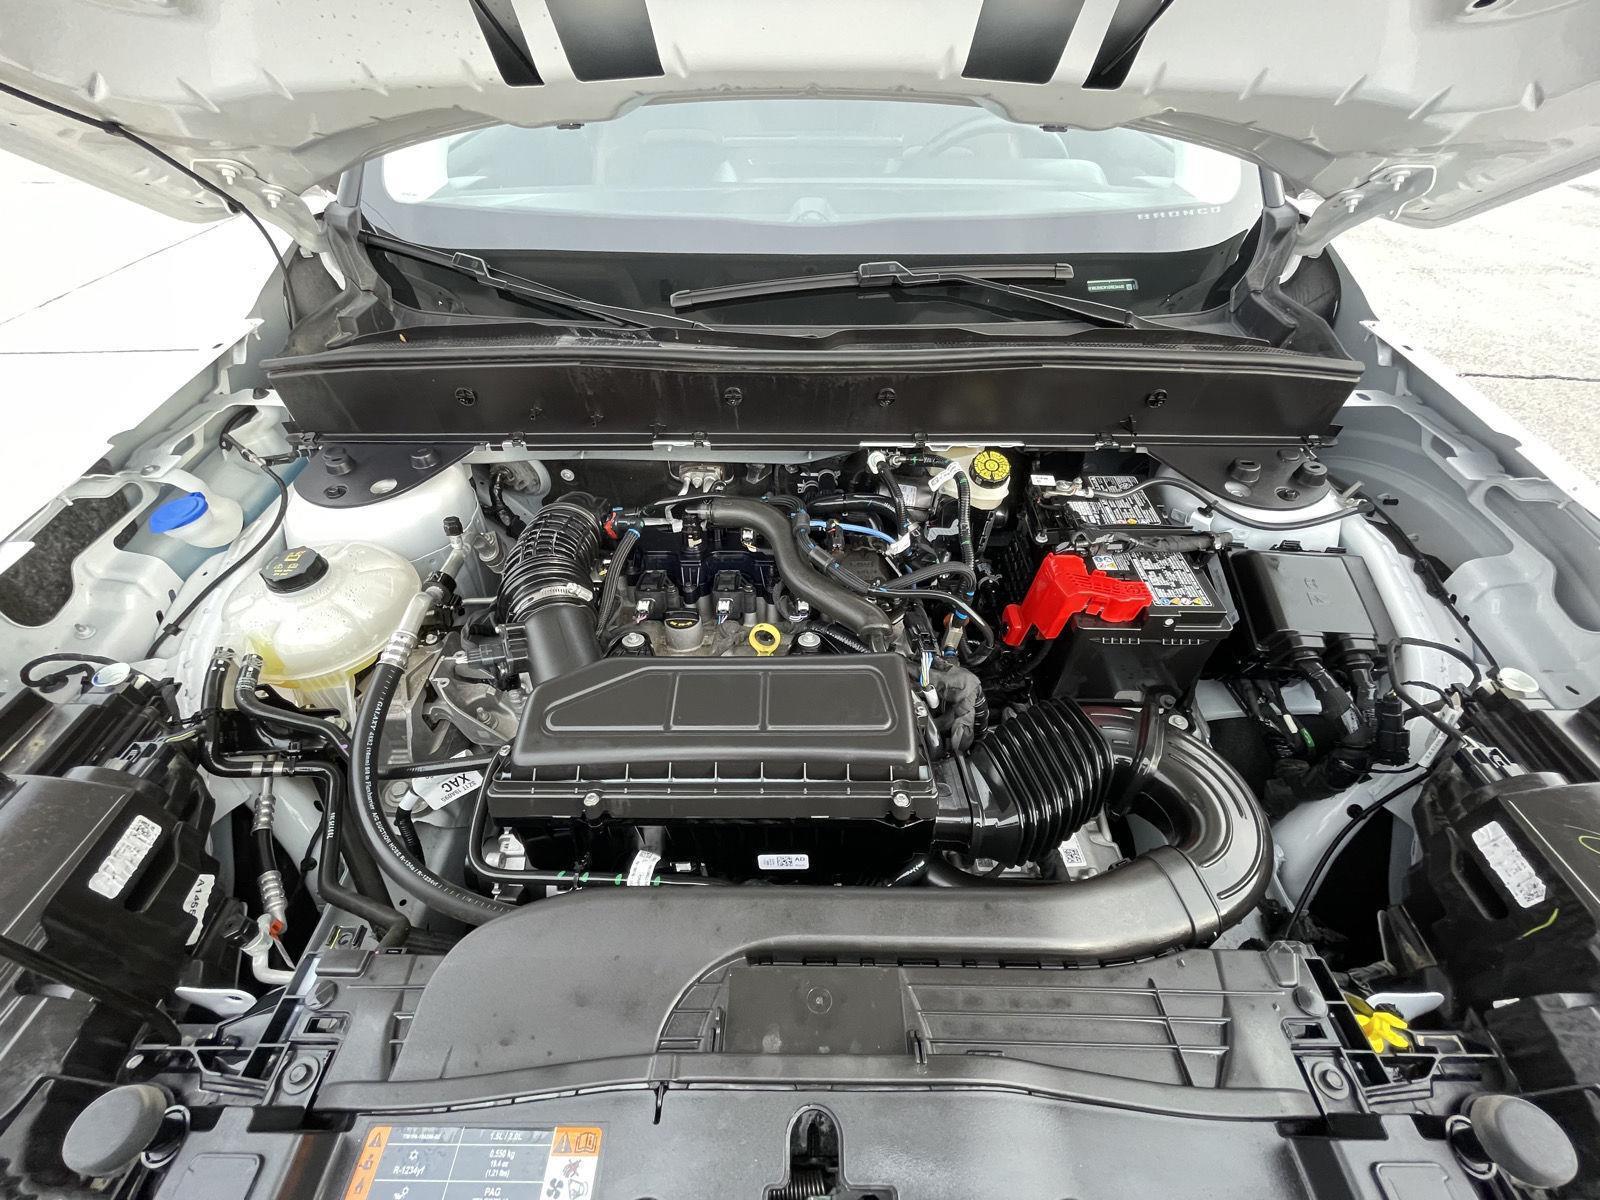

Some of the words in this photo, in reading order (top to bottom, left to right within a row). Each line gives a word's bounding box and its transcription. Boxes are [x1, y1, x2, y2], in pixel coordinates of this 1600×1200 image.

[1136, 205, 1221, 220] BRONCO
[370, 701, 384, 731] GALAXY
[388, 842, 402, 857] HOSE
[441, 773, 470, 793] XAC
[392, 1165, 426, 1177] R-1234yf
[484, 1187, 502, 1197] PAG
